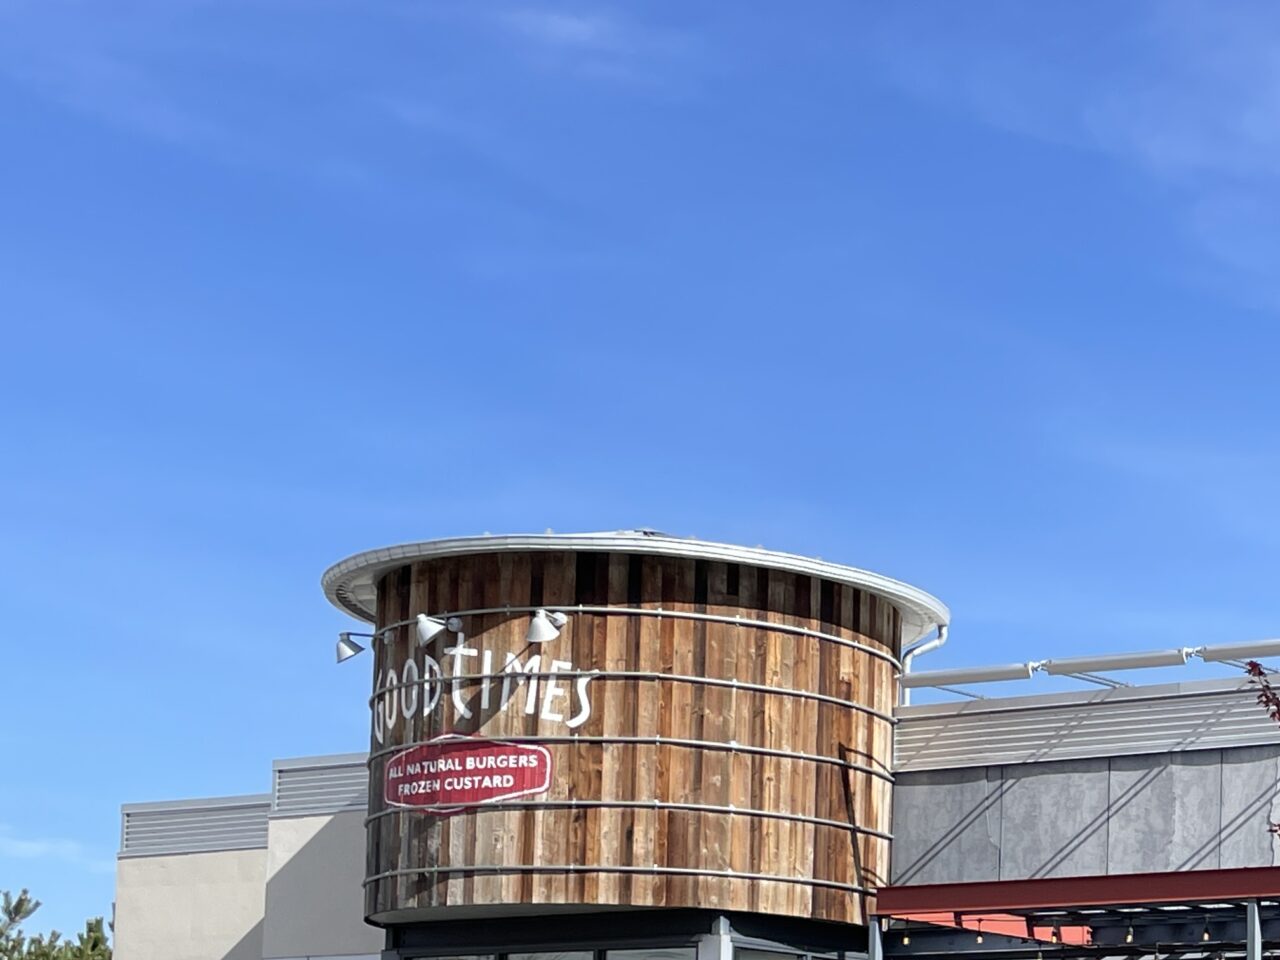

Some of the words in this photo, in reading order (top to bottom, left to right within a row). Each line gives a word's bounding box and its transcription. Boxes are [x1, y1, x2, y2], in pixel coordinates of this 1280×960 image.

[389, 765, 403, 780] ALL
[406, 758, 463, 775] NATURAL
[465, 754, 538, 770] BURGERS
[398, 779, 441, 796] FROZEN
[444, 774, 515, 791] CUSTARD
